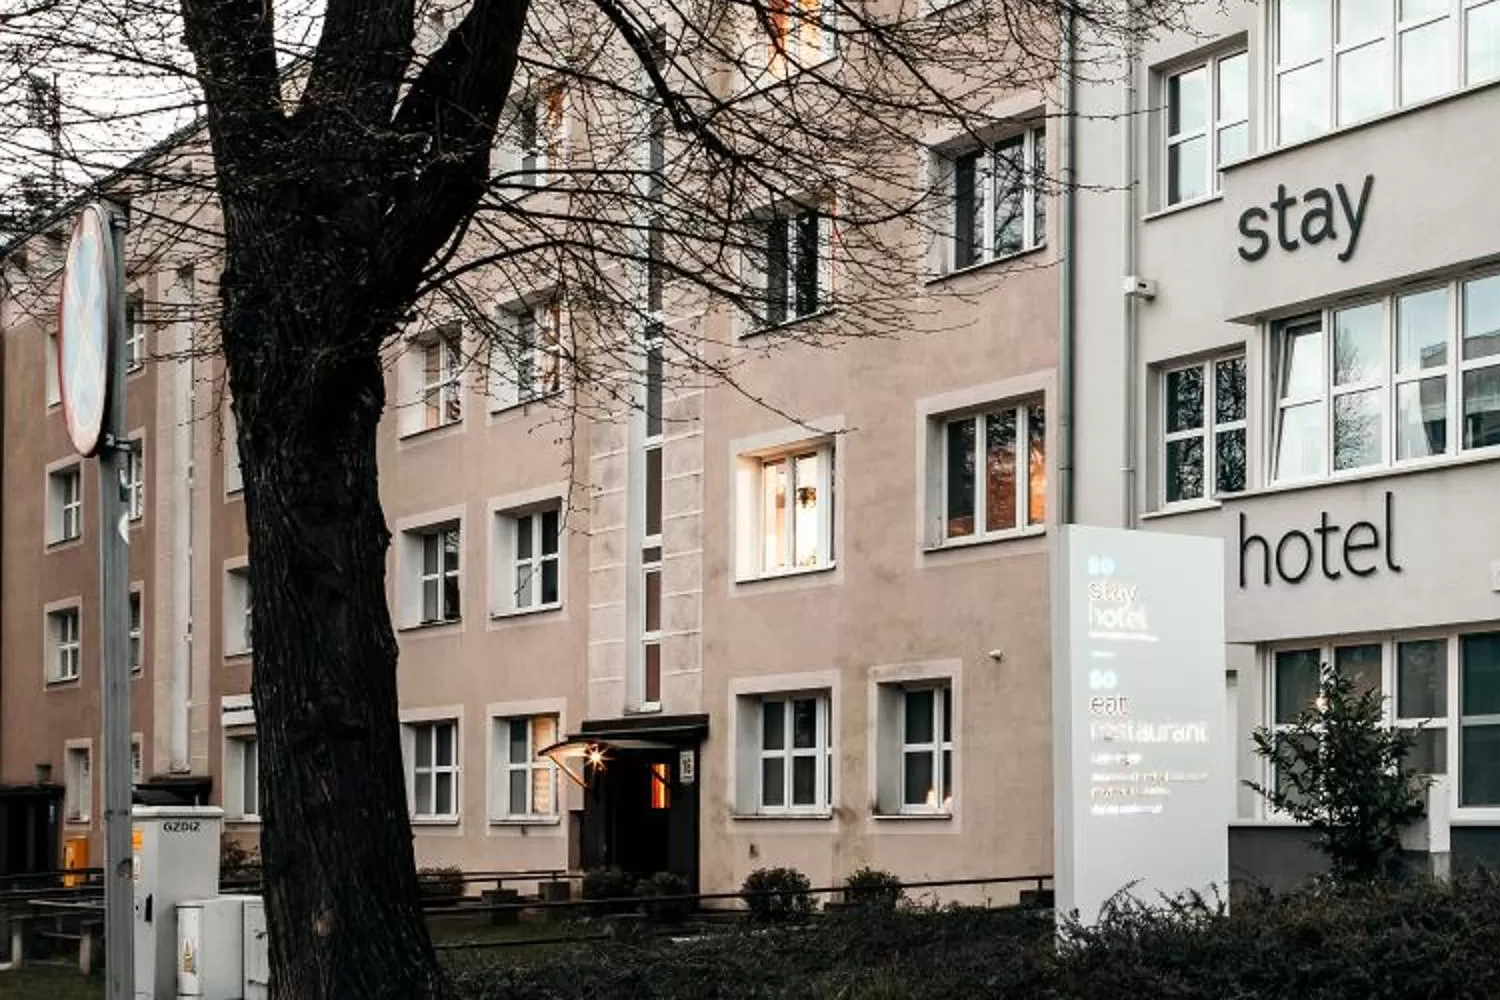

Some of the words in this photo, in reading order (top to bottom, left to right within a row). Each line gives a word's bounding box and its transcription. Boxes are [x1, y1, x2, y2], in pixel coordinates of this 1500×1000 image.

[1238, 174, 1374, 262] stay
[1239, 491, 1402, 588] hotel
[1089, 601, 1147, 630] hotel
[1090, 694, 1129, 715] eat
